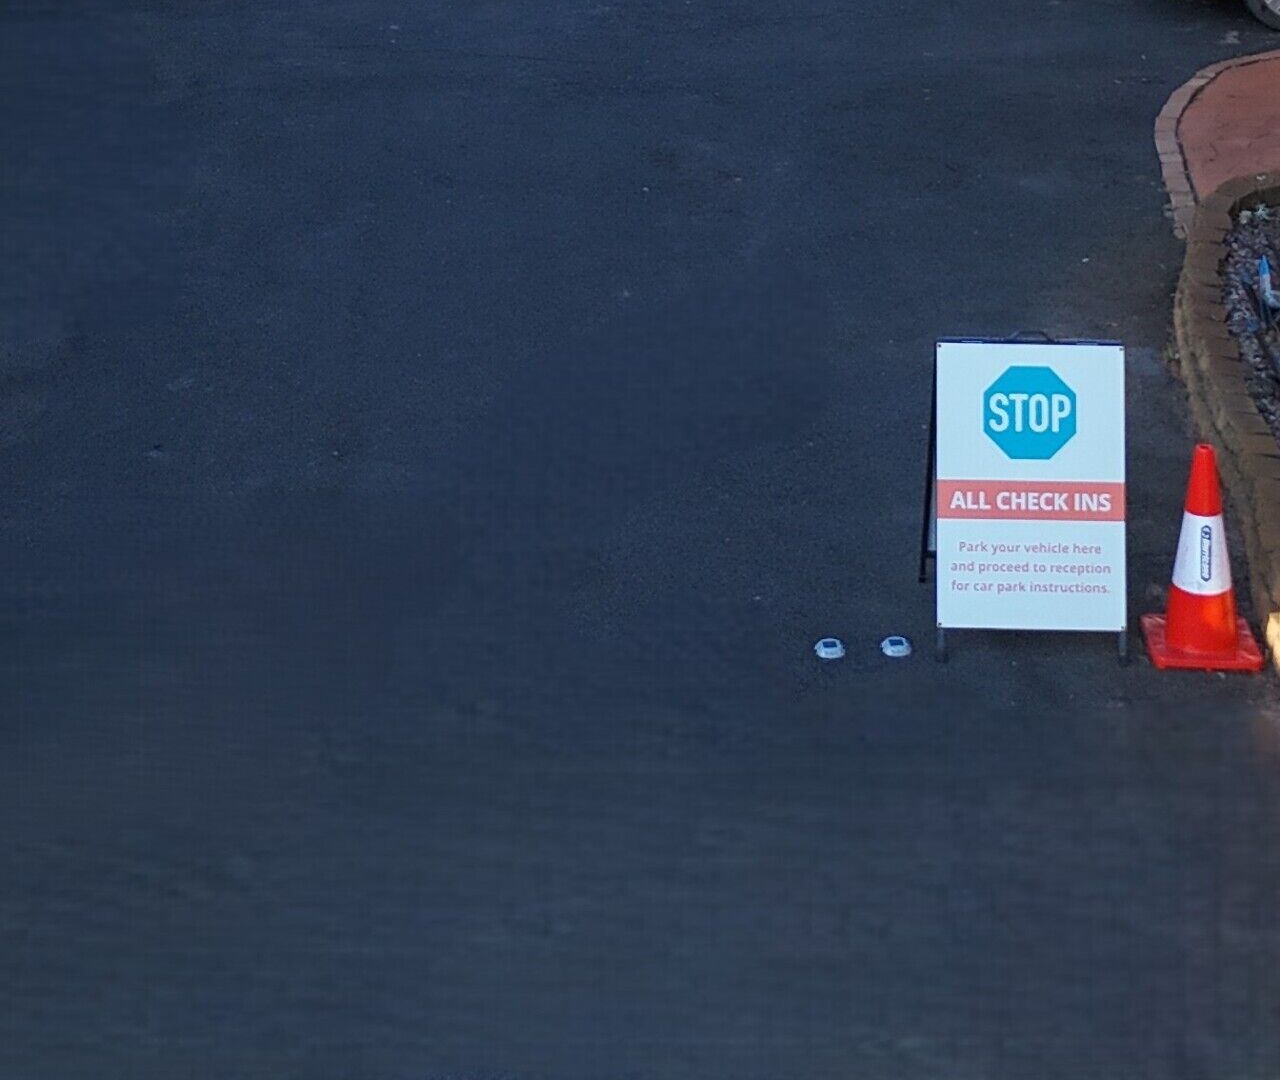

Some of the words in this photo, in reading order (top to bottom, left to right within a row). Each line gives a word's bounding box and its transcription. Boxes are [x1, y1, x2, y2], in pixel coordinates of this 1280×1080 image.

[988, 392, 1071, 433] STOP
[950, 490, 991, 510] ALL
[996, 491, 1069, 512] CHECK
[1074, 492, 1112, 513] INS
[958, 541, 989, 553] Park
[991, 544, 1020, 556] your
[1023, 542, 1069, 554] vehicle
[1072, 543, 1102, 554] here
[950, 561, 975, 572] and
[978, 561, 1029, 574] proceed
[1033, 562, 1047, 573] to
[1050, 563, 1112, 576] reception
[951, 579, 970, 591] for
[973, 582, 993, 592] car
[997, 581, 1026, 595] park
[1029, 581, 1111, 594] instructions.
